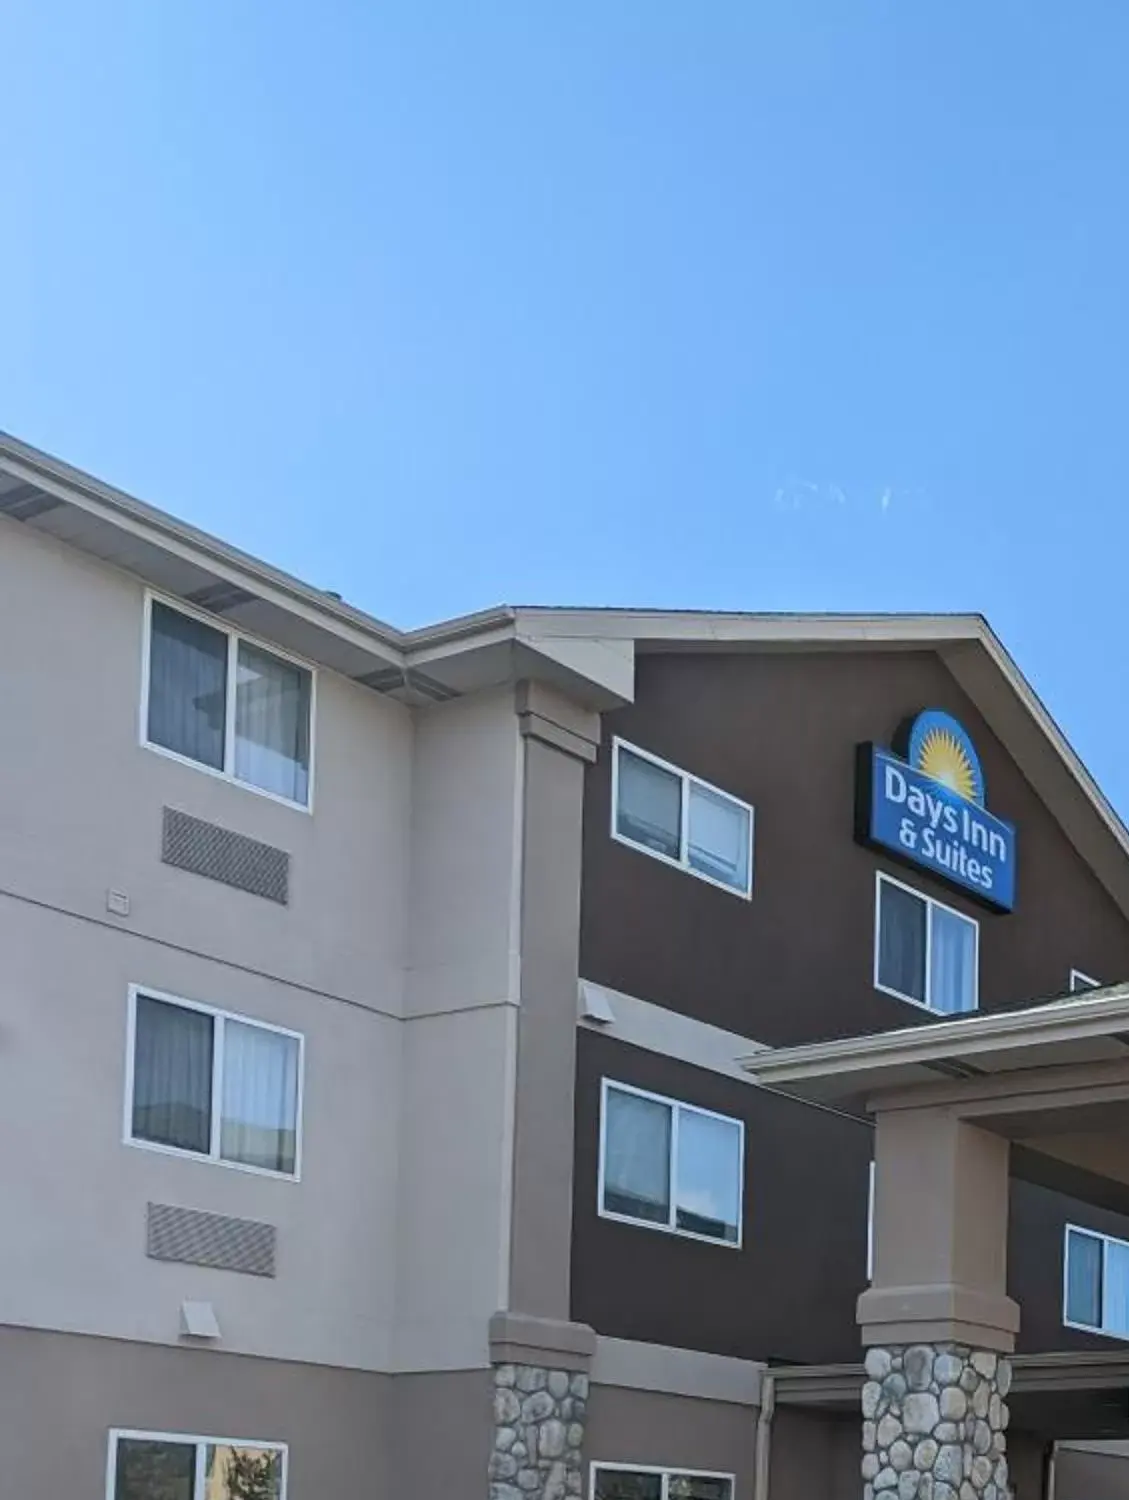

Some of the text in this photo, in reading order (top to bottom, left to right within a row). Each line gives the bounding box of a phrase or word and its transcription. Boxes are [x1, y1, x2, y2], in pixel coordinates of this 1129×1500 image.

[885, 765, 1006, 862] Days Inn
[900, 818, 993, 888] & Suites
